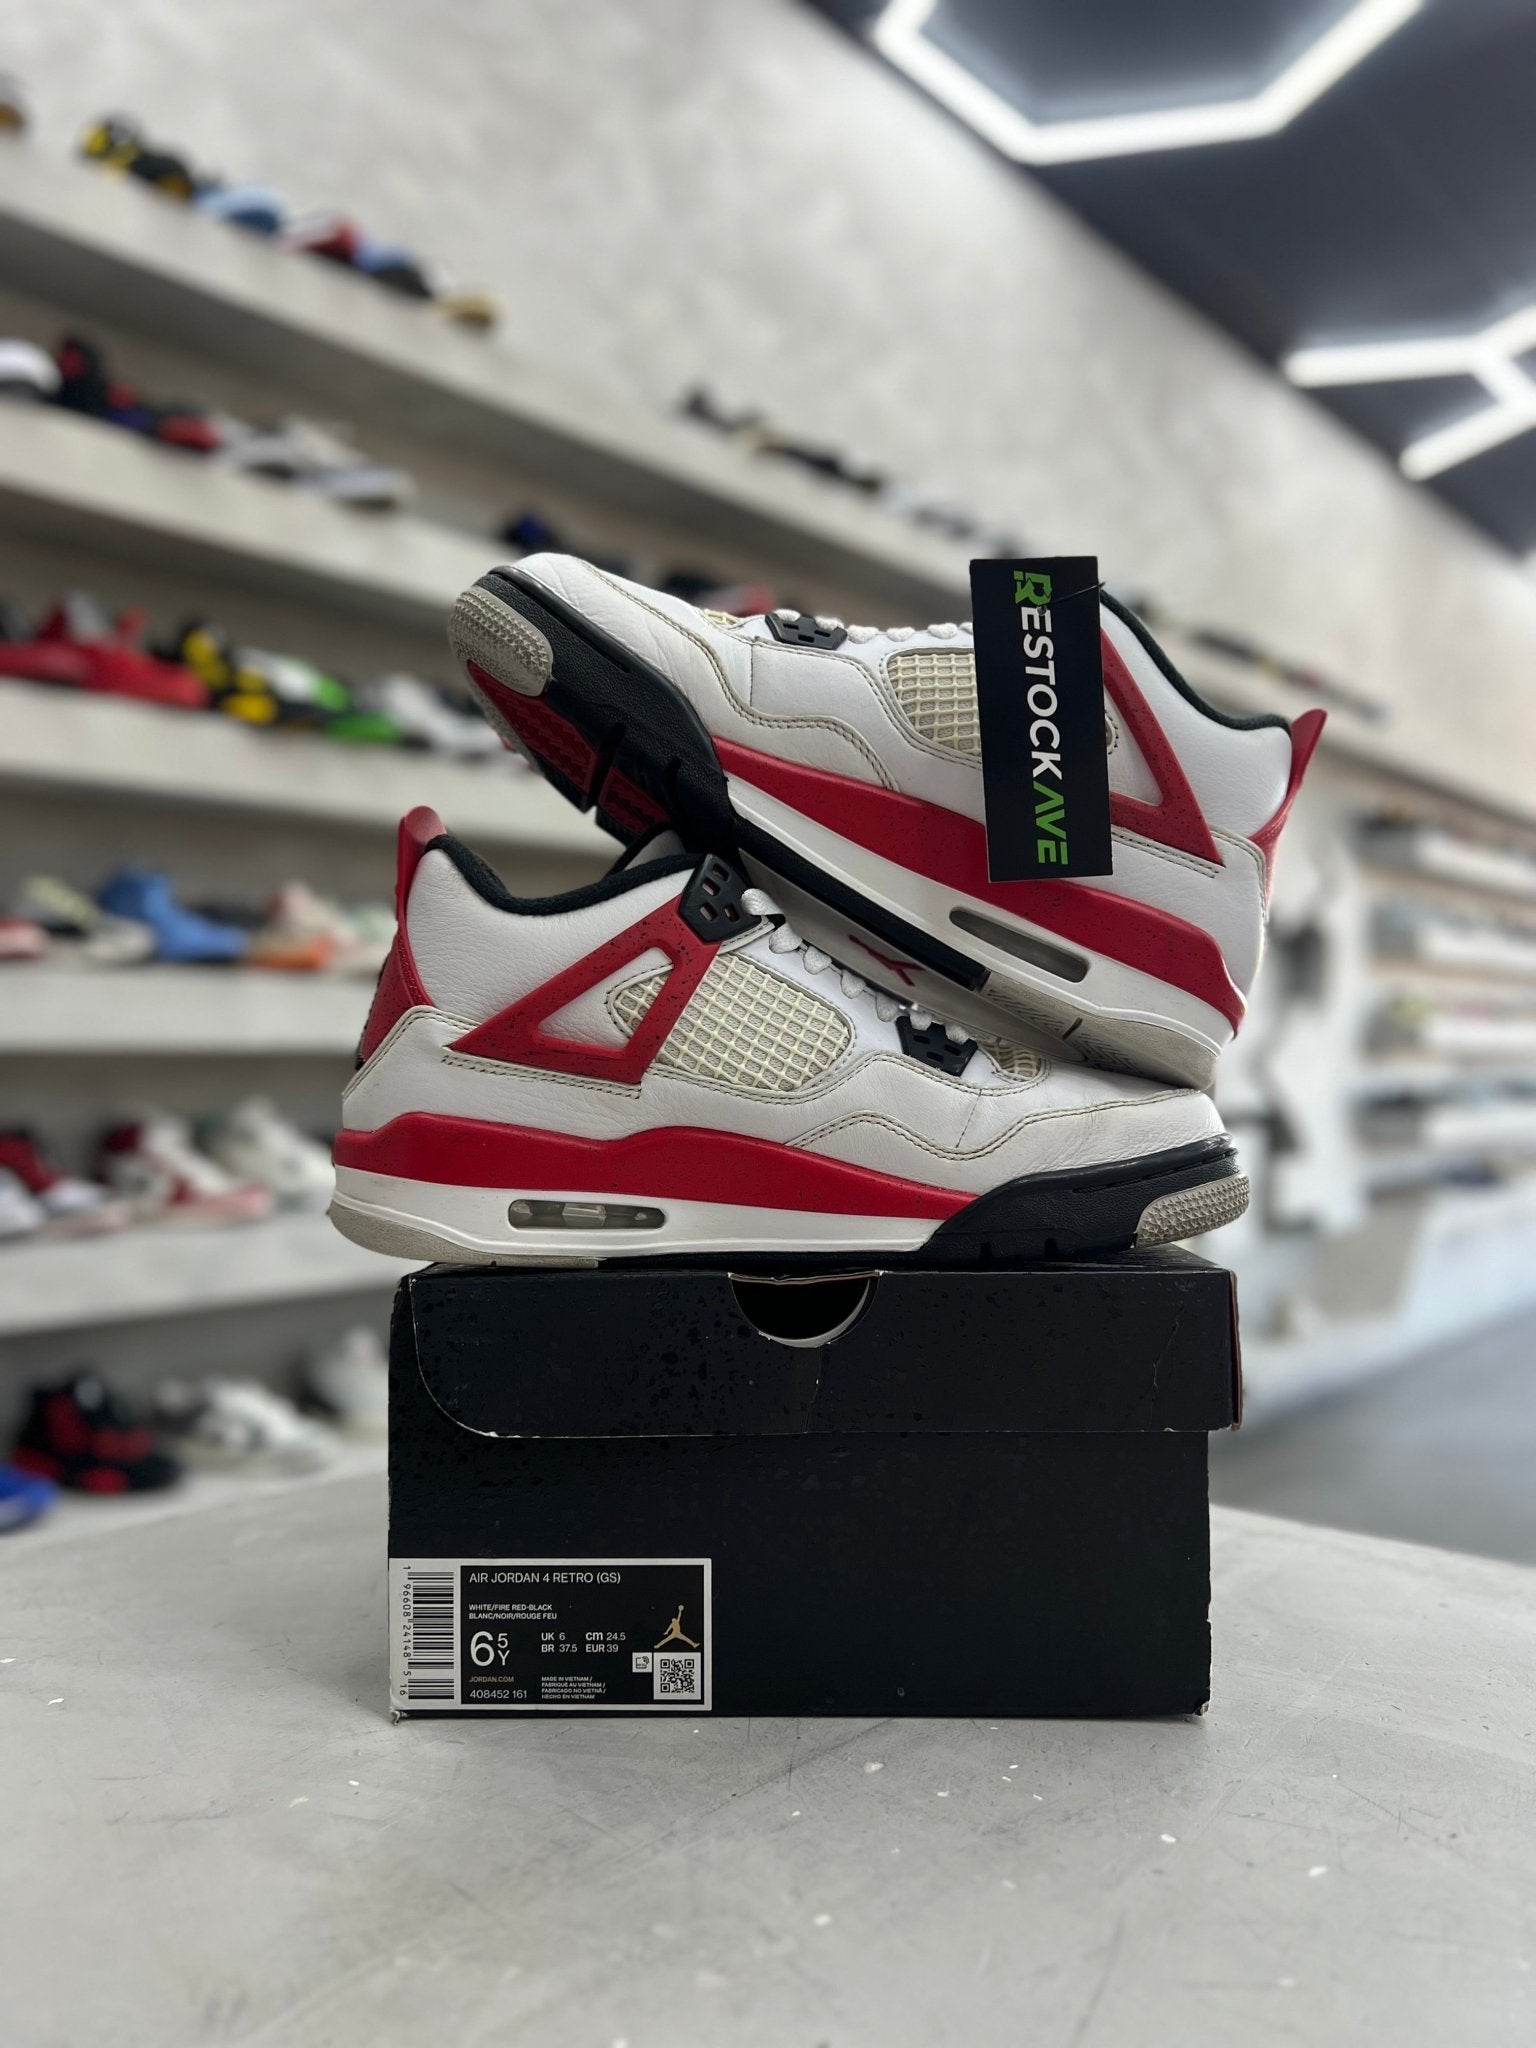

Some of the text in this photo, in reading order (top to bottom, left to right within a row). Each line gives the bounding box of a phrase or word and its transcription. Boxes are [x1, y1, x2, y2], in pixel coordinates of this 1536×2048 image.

[469, 1572, 621, 1584] AIR JORDAN 4 RETRO (GS)
[402, 1583, 412, 1617] 96608
[469, 1612, 558, 1620] BLANC/NOIR/ROUGE FEU
[402, 1624, 412, 1658] 24148
[497, 1633, 509, 1649] 5
[541, 1632, 566, 1641] UK 6
[585, 1632, 626, 1641] cm 24.5
[470, 1630, 495, 1667] 6
[541, 1644, 578, 1653] BR 37.5
[585, 1644, 619, 1653] EUR 39
[497, 1650, 510, 1666] Y
[400, 1683, 408, 1696] 16
[469, 1689, 528, 1699] 408452 161
